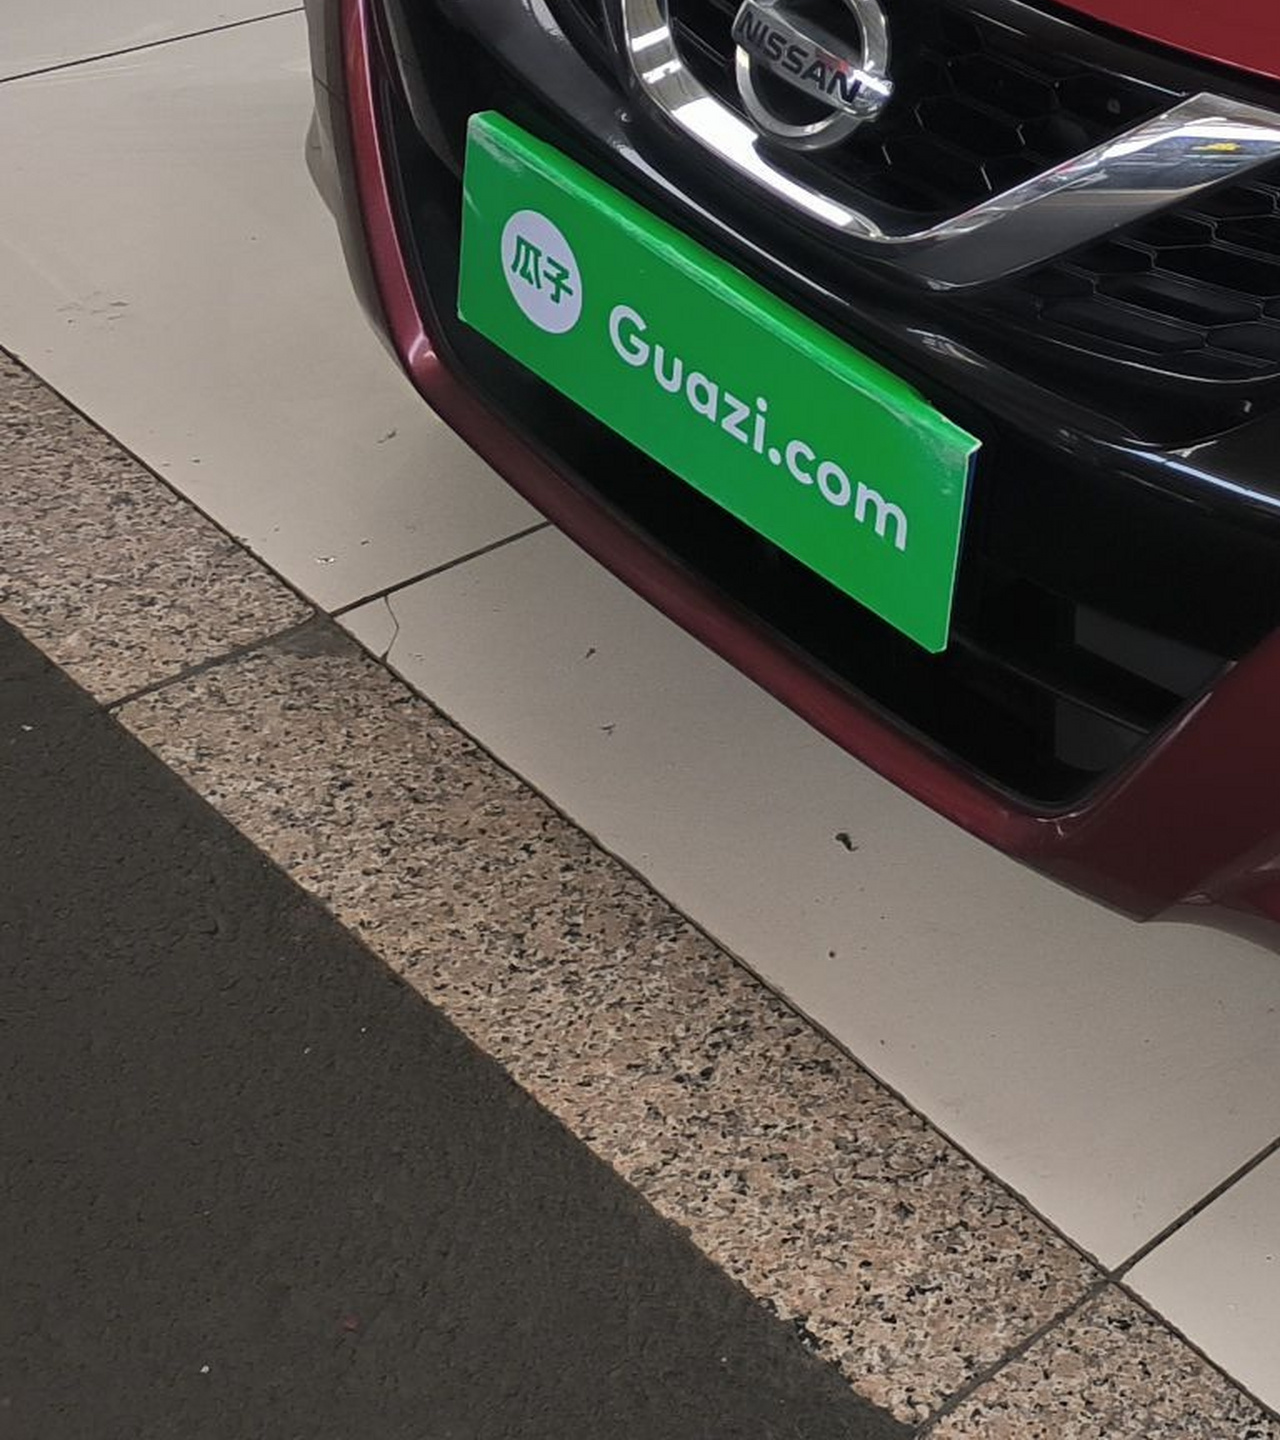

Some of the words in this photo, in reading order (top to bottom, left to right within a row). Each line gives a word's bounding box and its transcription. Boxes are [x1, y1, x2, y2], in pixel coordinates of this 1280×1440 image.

[739, 9, 862, 104] NISSAN
[511, 235, 575, 304] 瓜子
[608, 305, 908, 552] Guazi.com
